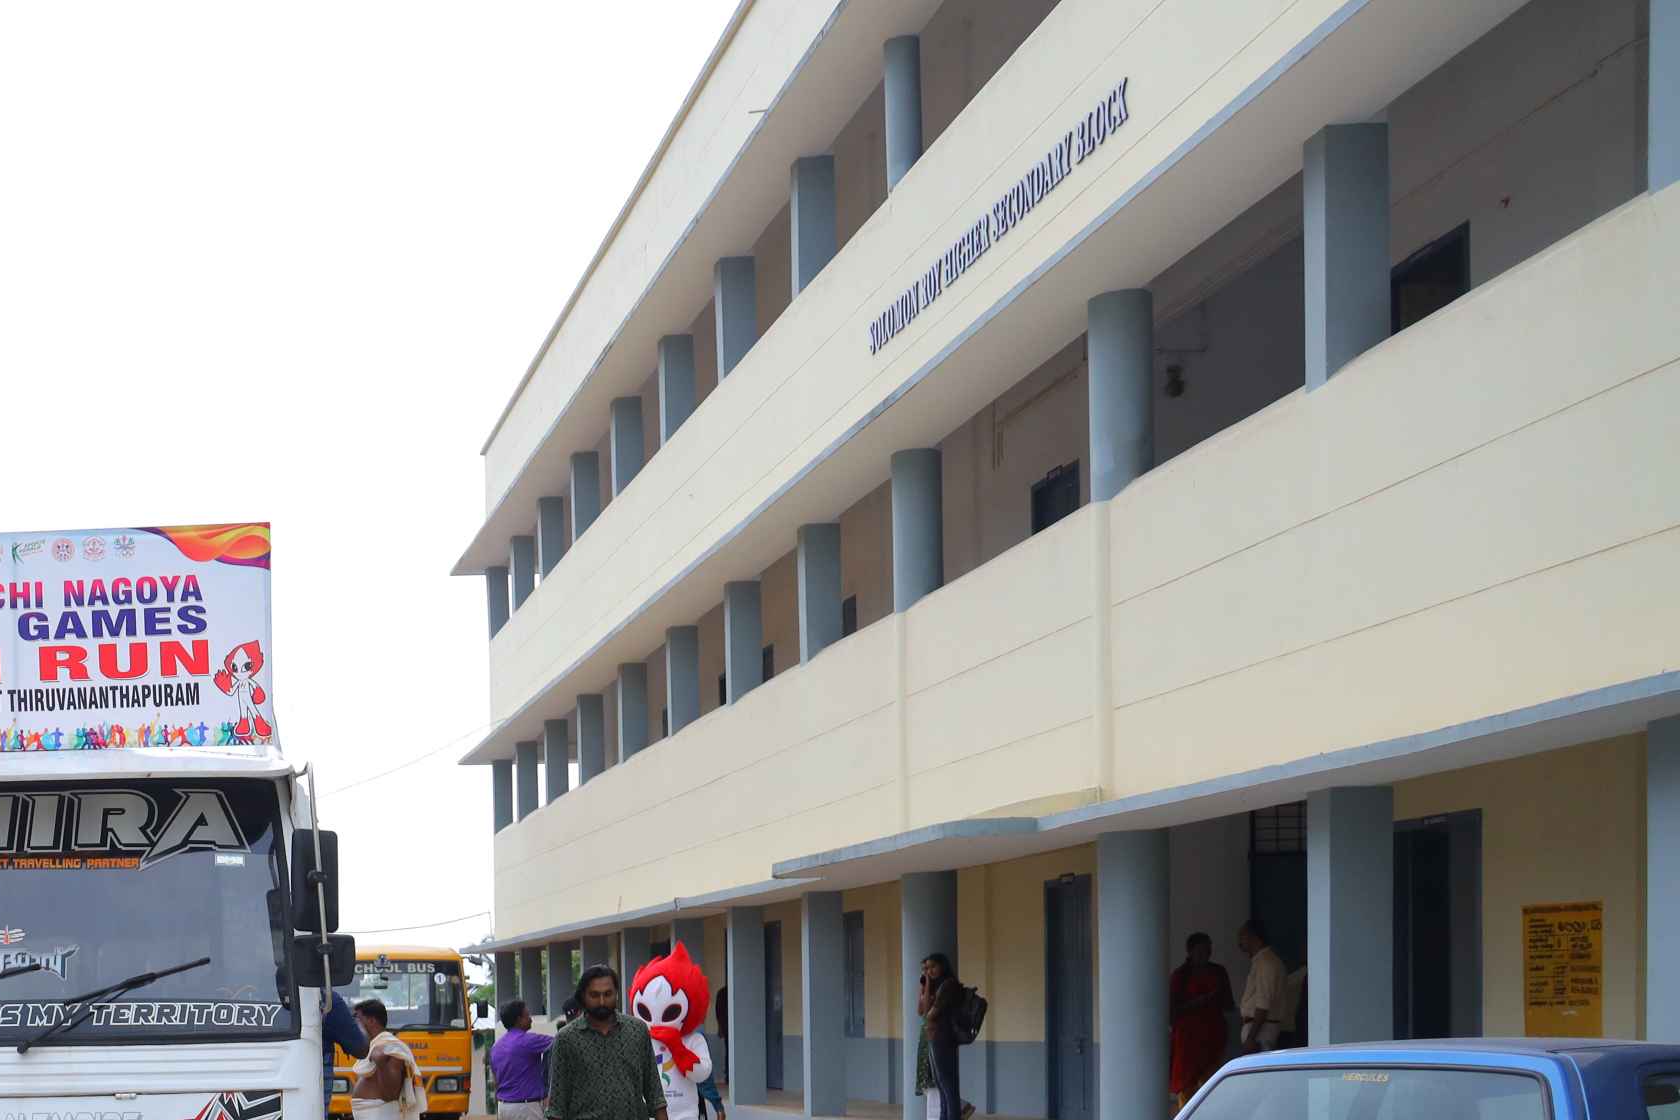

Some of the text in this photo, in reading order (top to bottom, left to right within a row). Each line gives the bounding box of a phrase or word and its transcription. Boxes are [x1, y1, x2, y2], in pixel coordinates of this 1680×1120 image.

[868, 77, 1129, 355] SOLOMON ROY HIGHER SECONDARY BLOCK
[63, 574, 204, 608] NAGOYA
[17, 605, 208, 641] GAMES
[38, 639, 210, 682] RUN
[7, 682, 201, 713] THIRUVANANTHAPURAM
[13, 857, 81, 869] TRAVELLING
[86, 857, 139, 869] PARTNER
[408, 963, 435, 973] BUS
[27, 1003, 80, 1027] MY
[88, 1001, 283, 1027] TERRITORY
[1343, 1072, 1390, 1083] HERCULES
